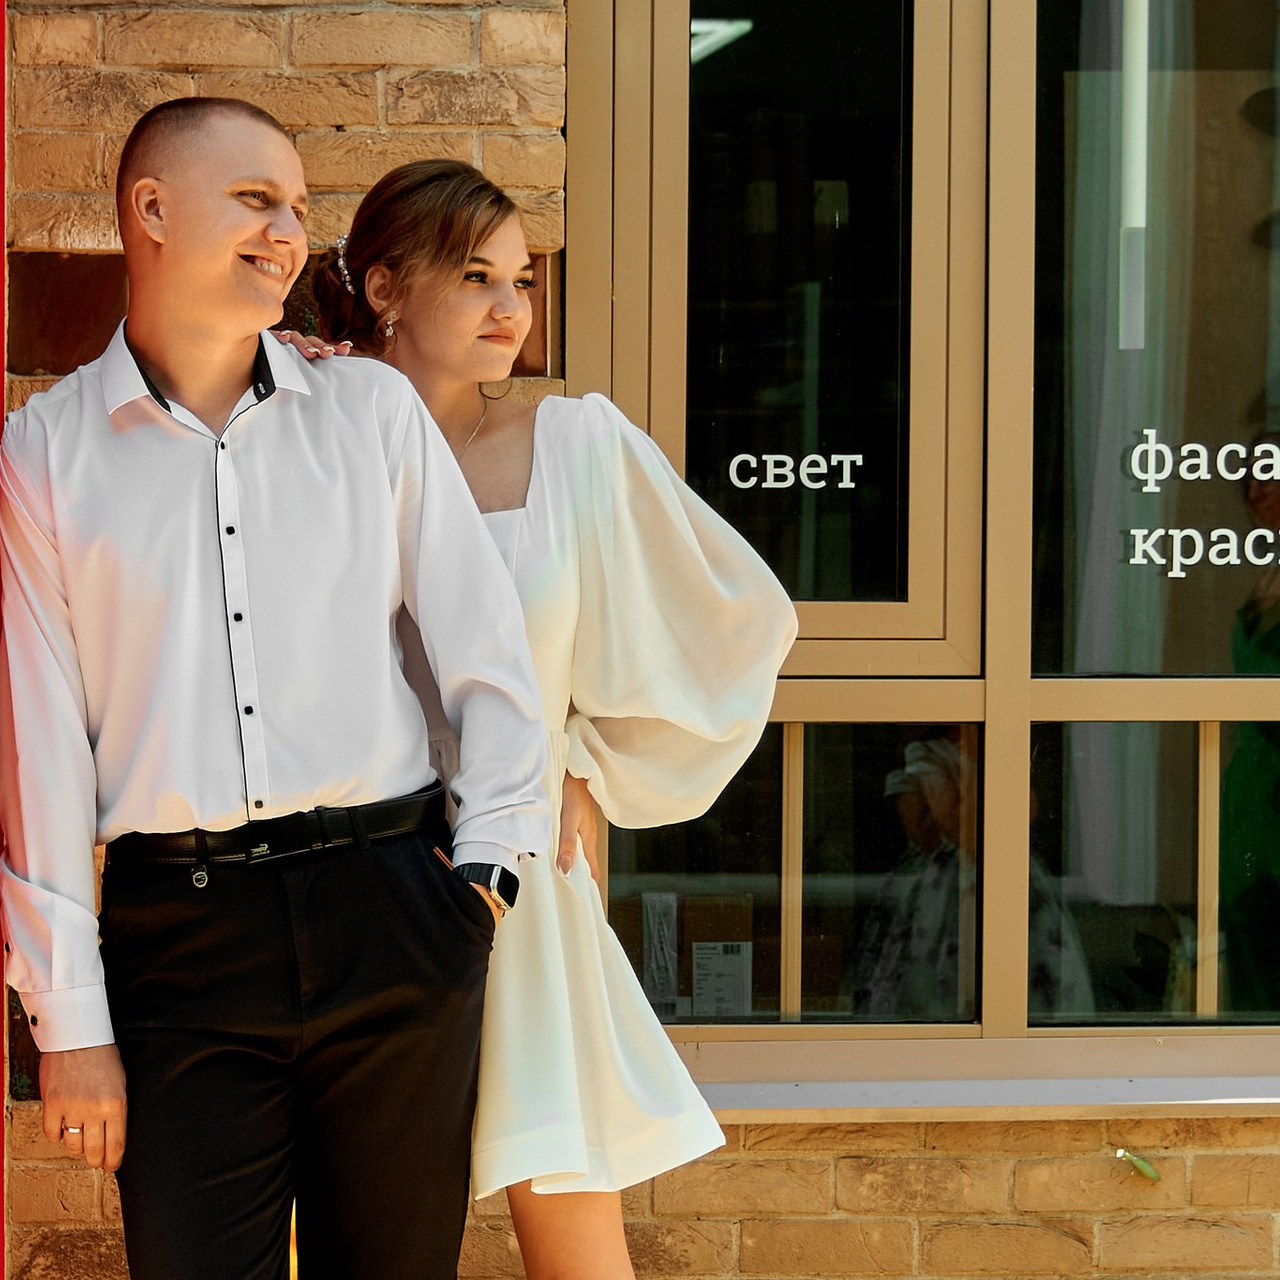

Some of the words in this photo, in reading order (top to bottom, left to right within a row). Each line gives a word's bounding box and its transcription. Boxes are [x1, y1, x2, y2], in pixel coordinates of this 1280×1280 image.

[728, 453, 863, 489] свет
[1130, 428, 1280, 493] фаса
[1129, 528, 1280, 578] крас
